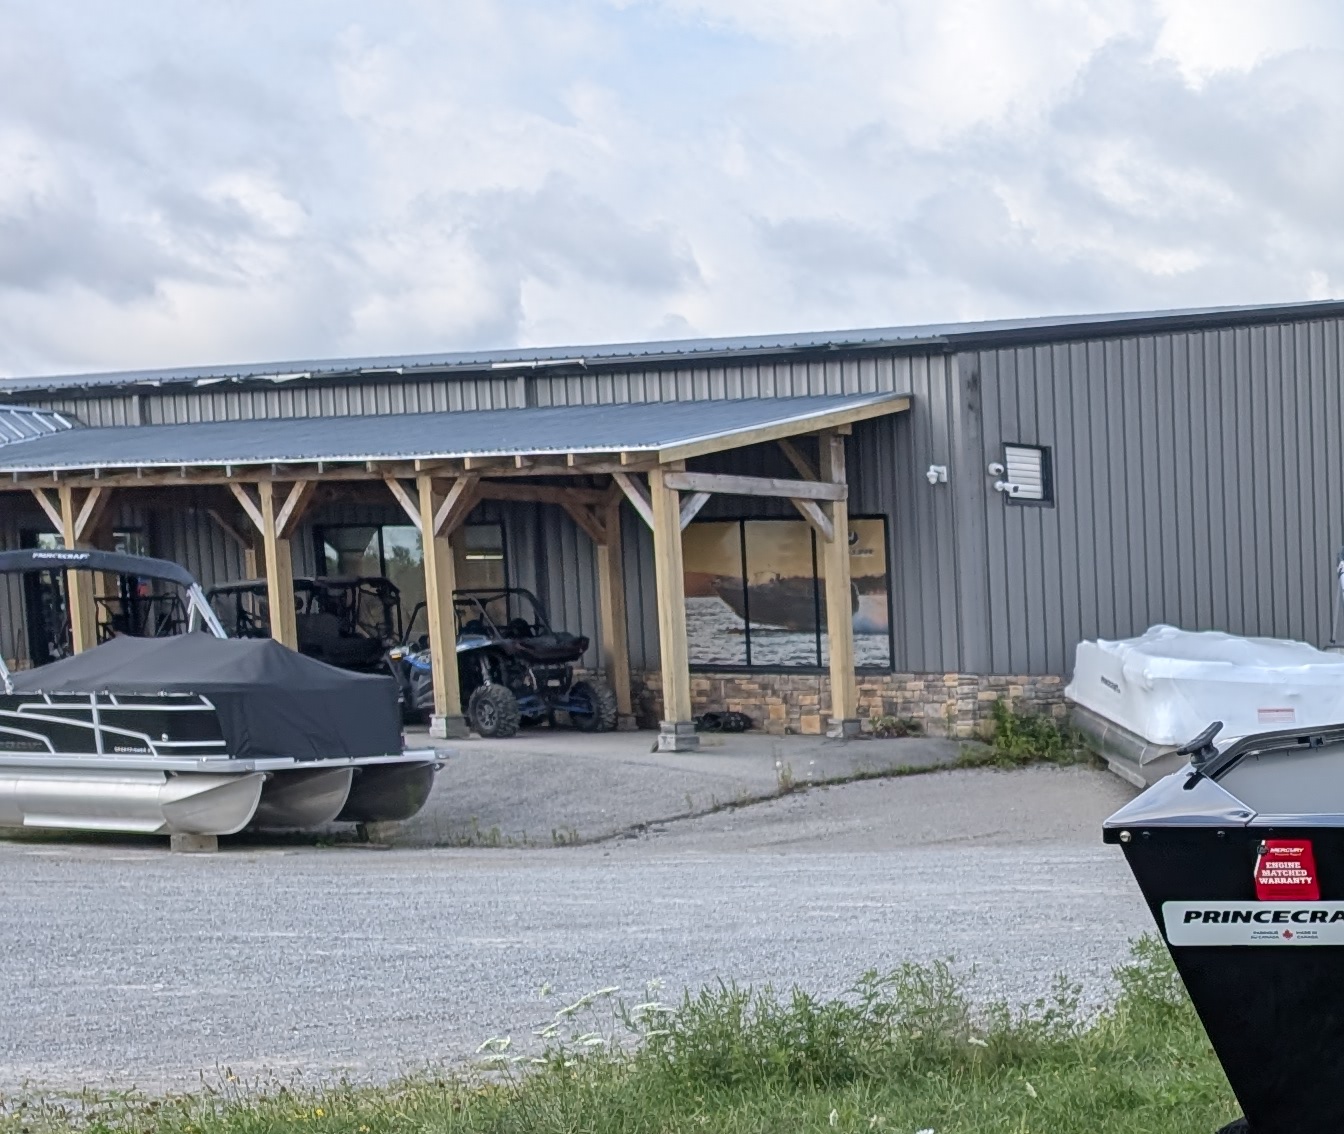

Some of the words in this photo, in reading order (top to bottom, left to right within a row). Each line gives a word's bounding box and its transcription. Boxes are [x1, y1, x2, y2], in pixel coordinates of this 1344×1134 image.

[1265, 861, 1301, 869] ENGINE
[1261, 869, 1308, 877] MATCHED
[1258, 876, 1313, 885] WARRANTY
